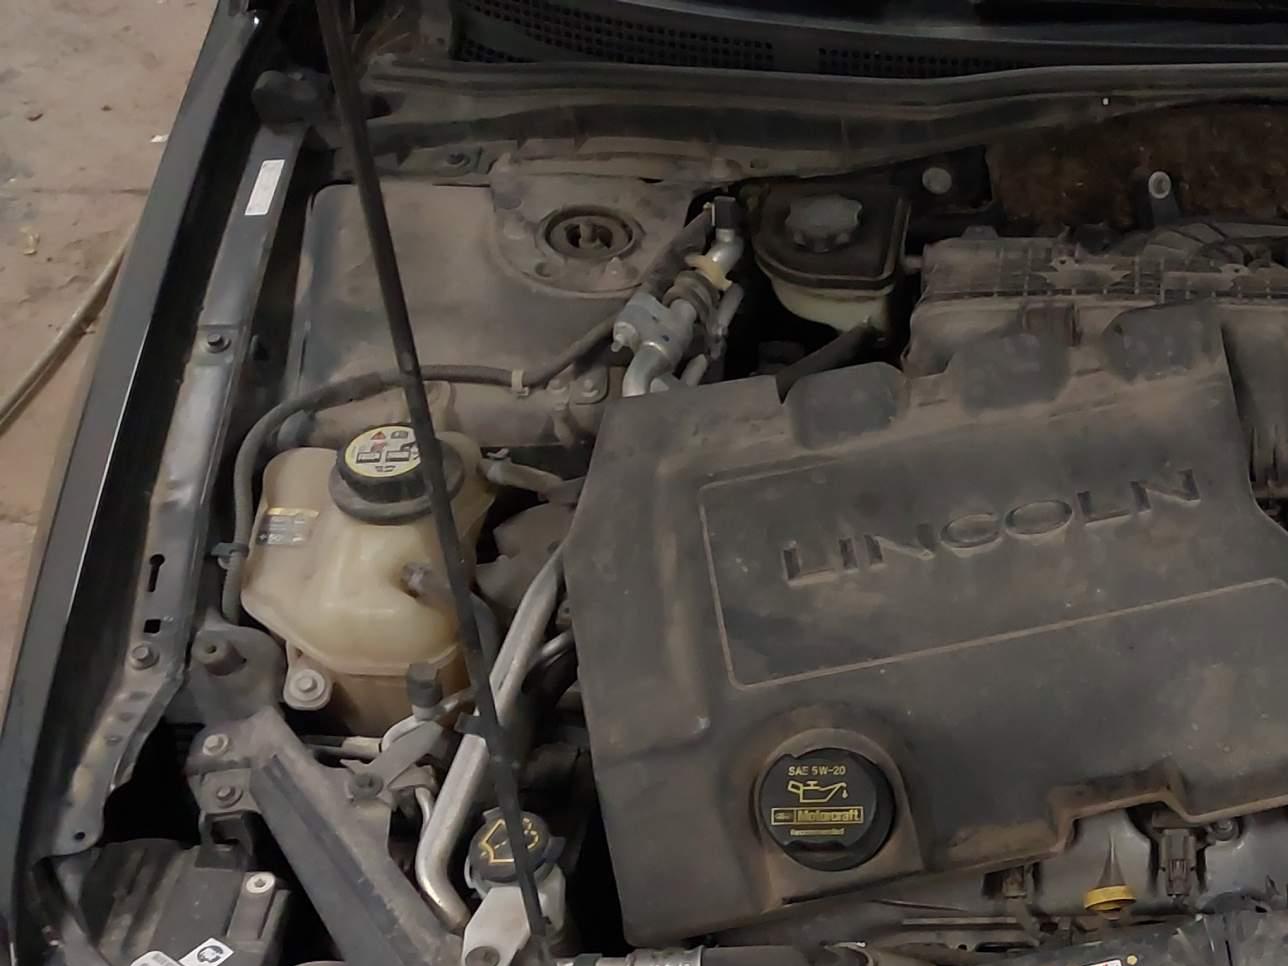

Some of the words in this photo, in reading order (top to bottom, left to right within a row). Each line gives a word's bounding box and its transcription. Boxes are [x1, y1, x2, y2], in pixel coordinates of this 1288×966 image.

[781, 469, 1201, 587] LINCOLN
[788, 766, 809, 776] SAE
[811, 765, 846, 775] 5W-20
[797, 809, 860, 822] Motorcraft
